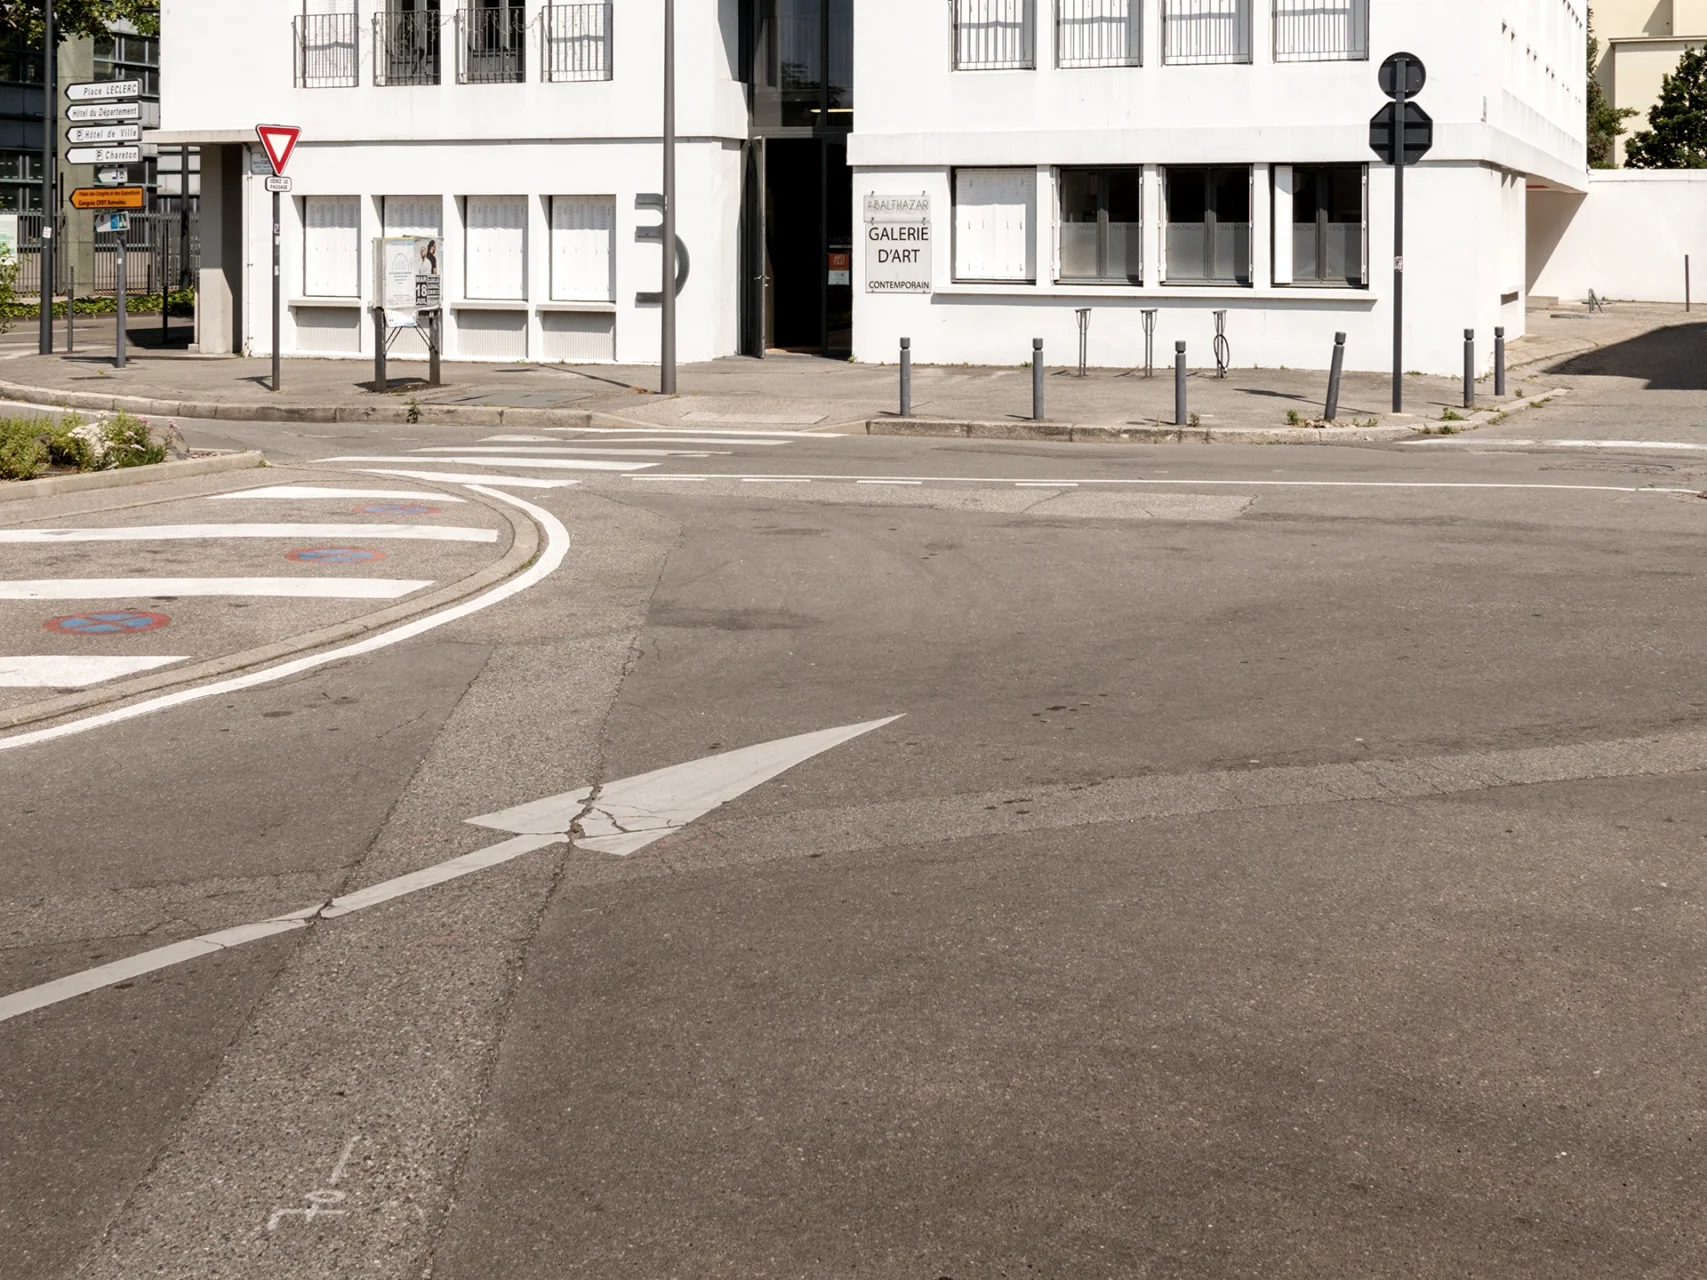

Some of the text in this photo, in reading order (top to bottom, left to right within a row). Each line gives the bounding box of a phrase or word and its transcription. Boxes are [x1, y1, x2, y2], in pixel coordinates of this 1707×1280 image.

[83, 84, 137, 96] Place LECLERC
[89, 108, 97, 117] du
[98, 107, 137, 118] Département
[84, 130, 104, 140] Hôtel
[107, 129, 116, 139] de
[120, 127, 137, 138] Ville
[105, 150, 137, 160] Chareton
[874, 199, 929, 211] BALTHAZAR
[868, 227, 929, 241] GALERIE
[878, 249, 920, 263] D'ART
[416, 284, 427, 297] 18
[868, 281, 930, 289] CONTEMPORAIN
